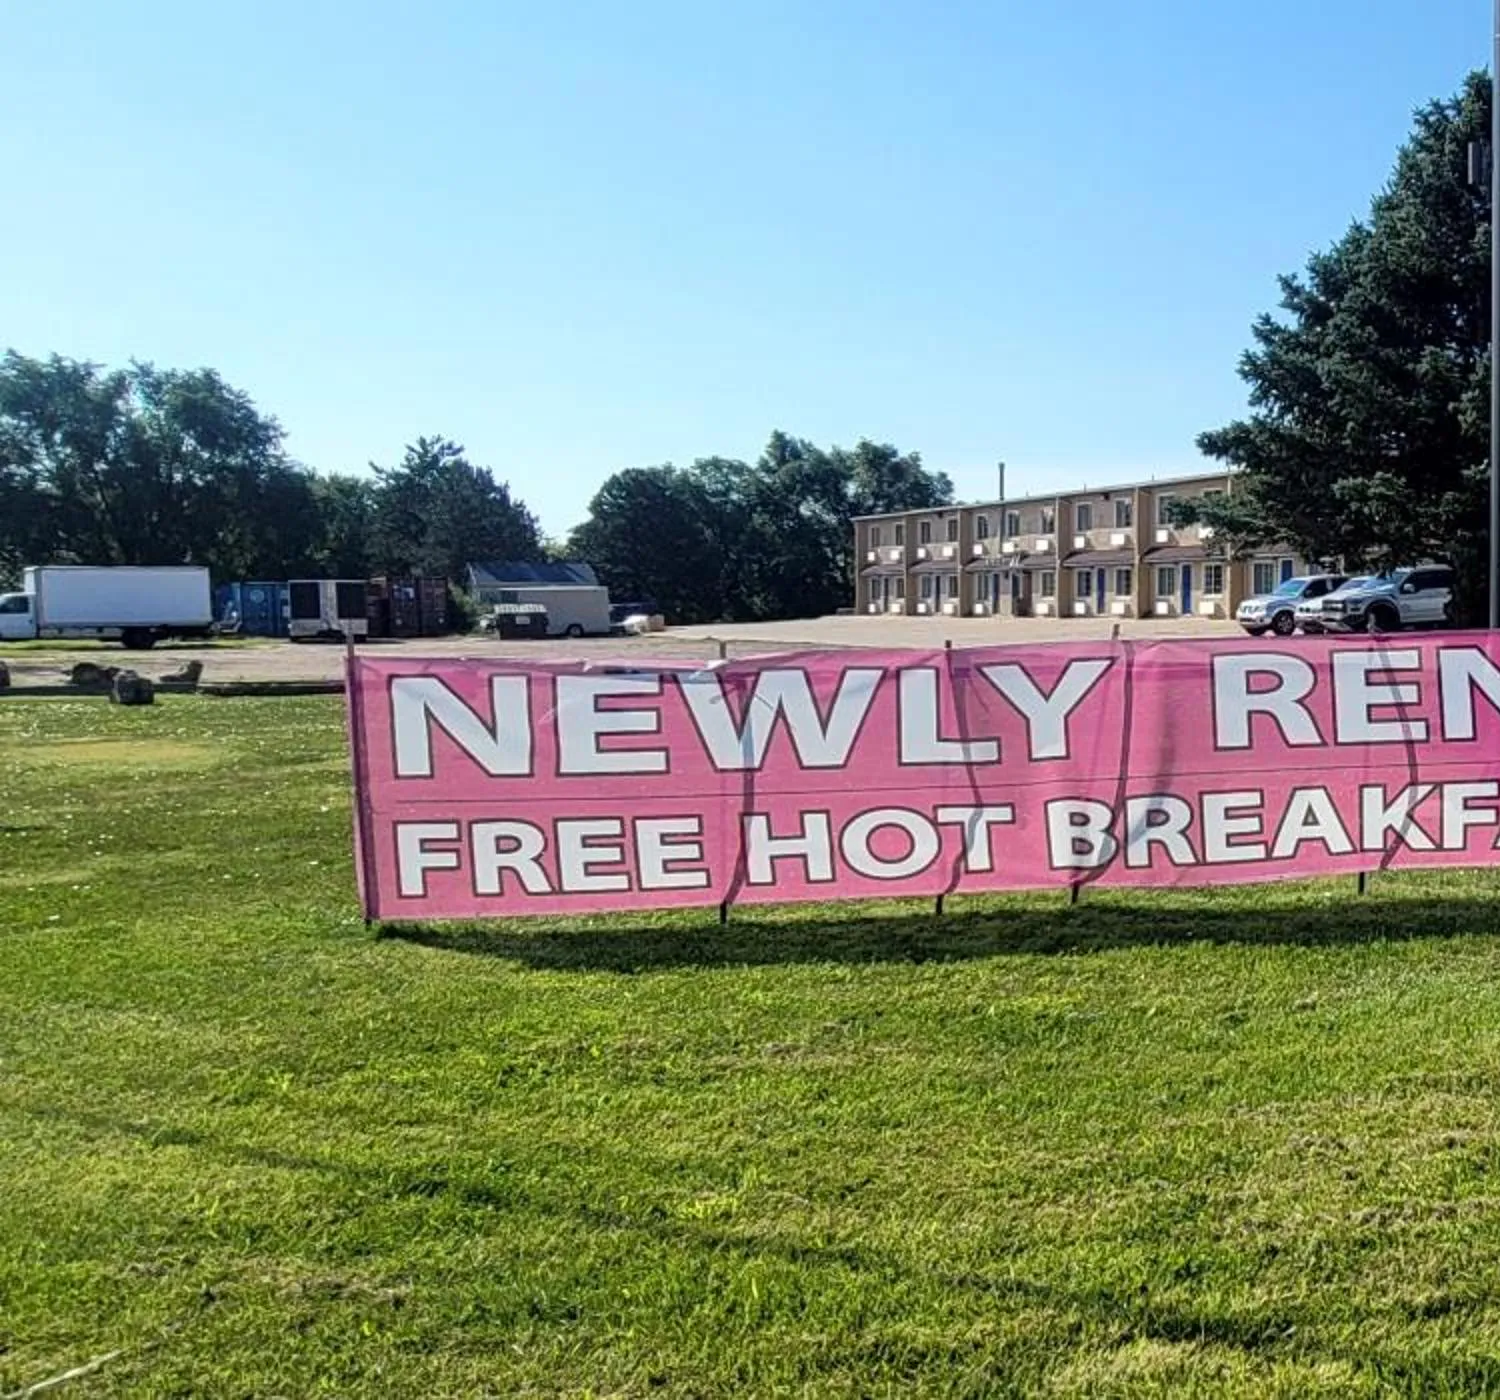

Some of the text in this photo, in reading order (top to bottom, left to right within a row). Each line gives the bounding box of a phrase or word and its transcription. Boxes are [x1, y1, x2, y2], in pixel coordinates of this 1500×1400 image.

[387, 656, 1118, 778] NEWLY
[394, 811, 711, 897] FREE
[741, 803, 1015, 886] HOT
